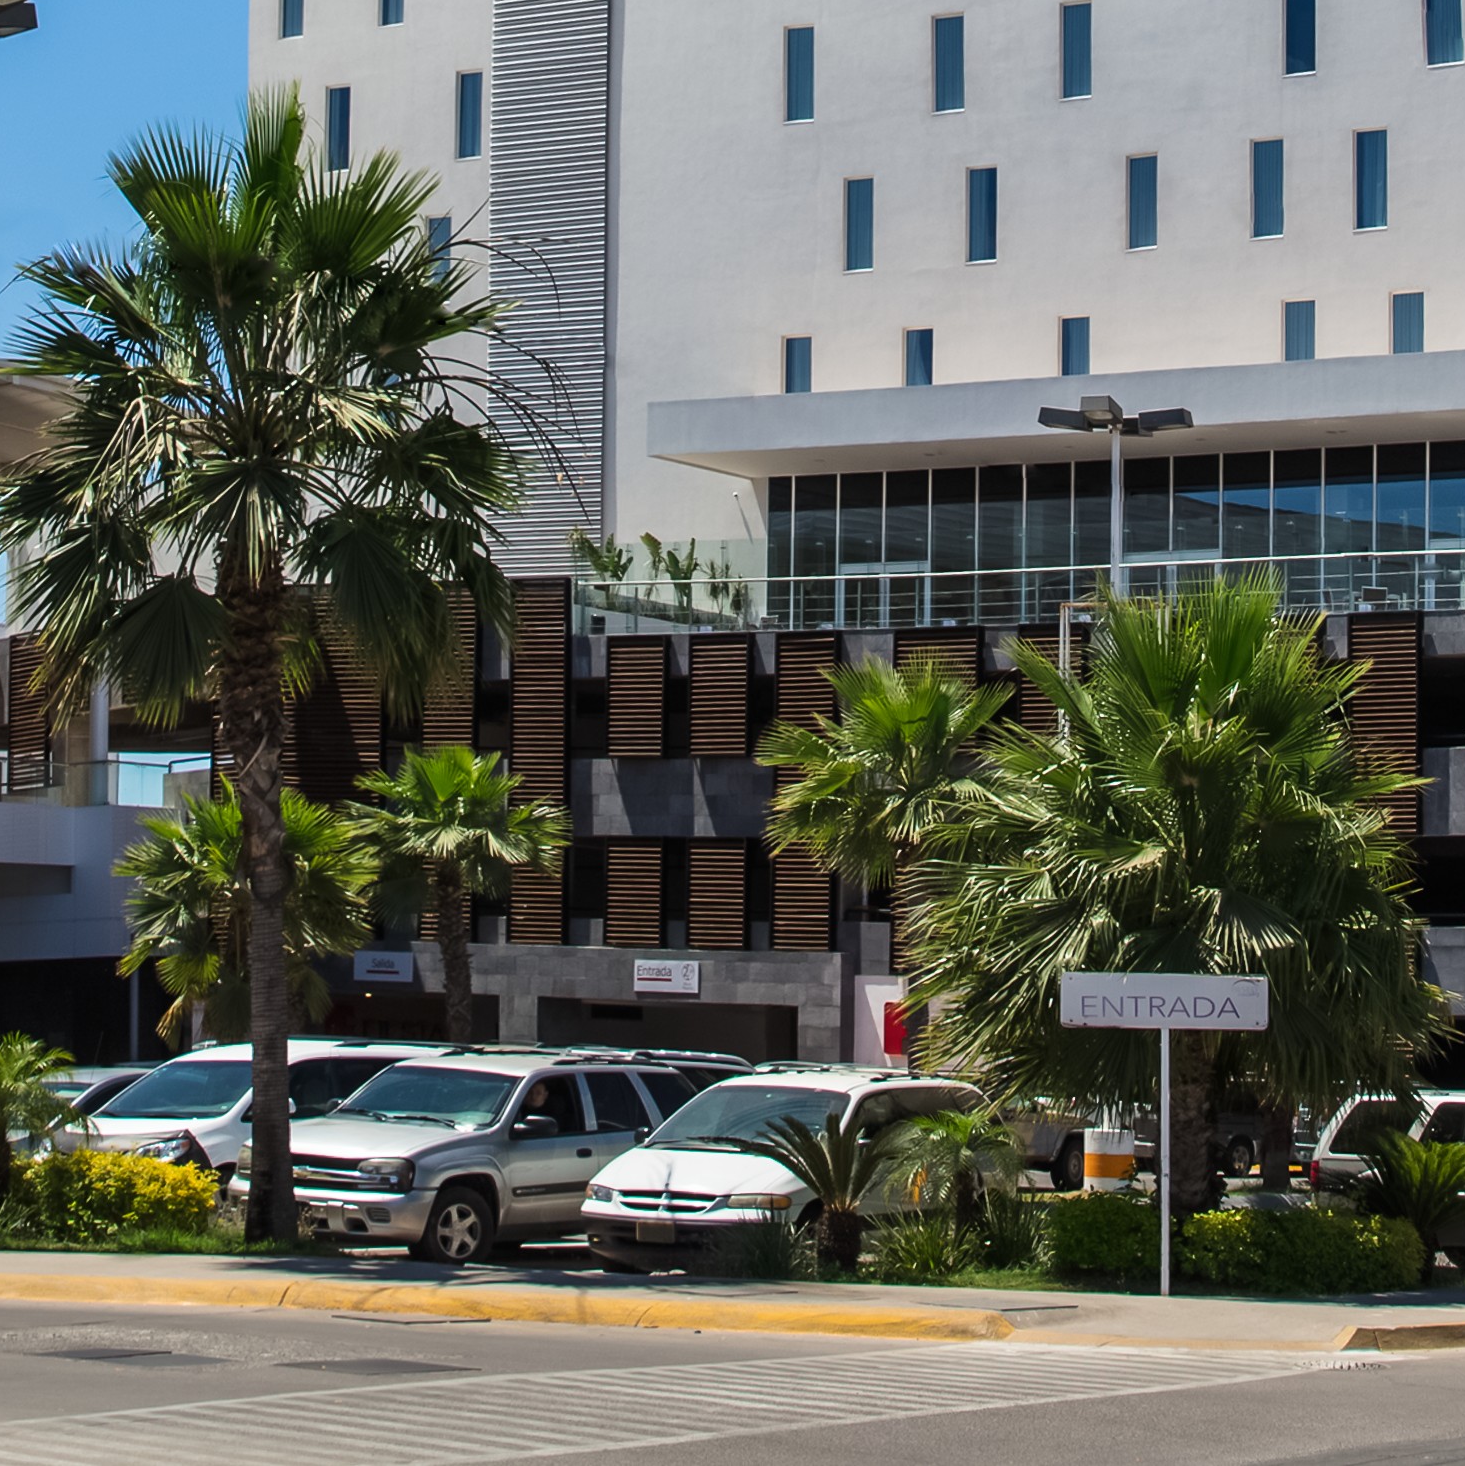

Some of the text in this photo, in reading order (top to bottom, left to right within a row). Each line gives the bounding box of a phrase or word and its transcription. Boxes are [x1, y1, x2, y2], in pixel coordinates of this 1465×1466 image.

[372, 958, 395, 968] Salida
[637, 965, 673, 977] Entrada
[1081, 995, 1241, 1019] ENTRADA
